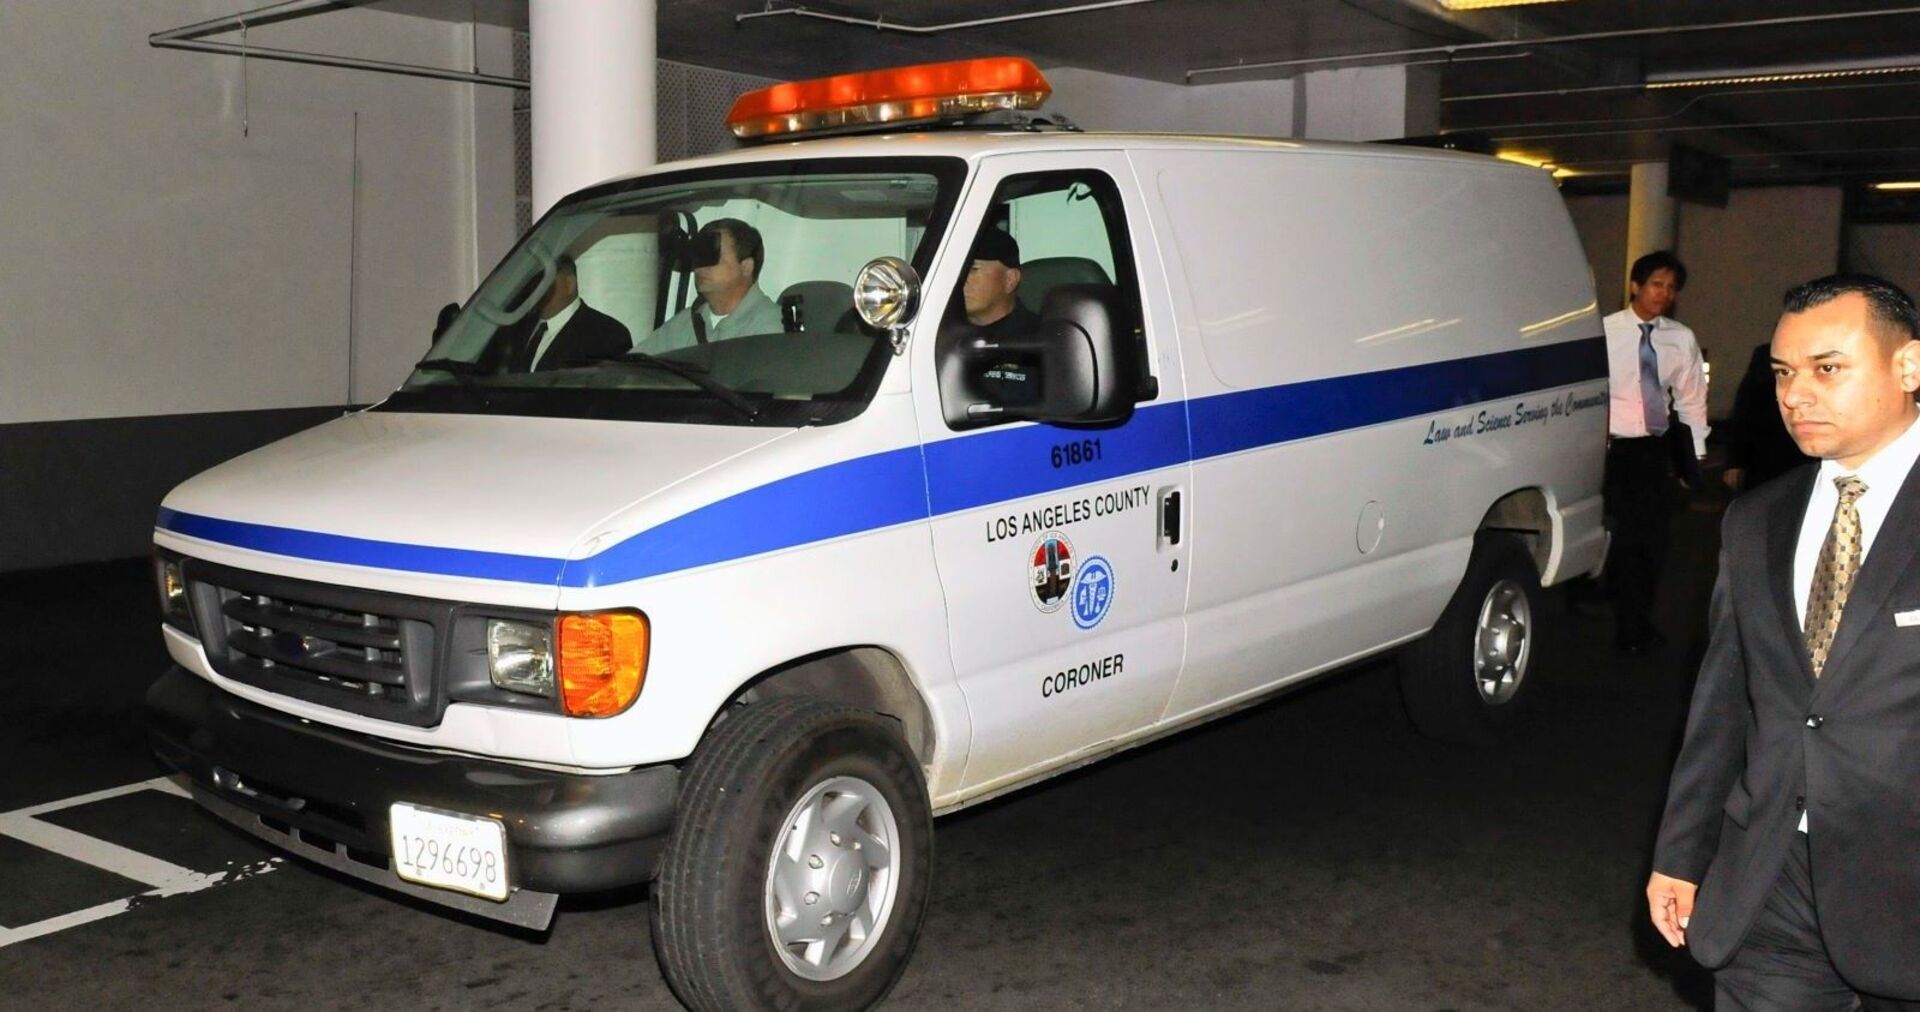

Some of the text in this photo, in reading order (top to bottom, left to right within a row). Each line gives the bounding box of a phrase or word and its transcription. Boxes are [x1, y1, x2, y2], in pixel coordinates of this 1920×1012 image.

[1423, 419, 1451, 445] Law
[1453, 415, 1474, 438] and
[1476, 410, 1512, 434] Science
[1514, 402, 1549, 425] Serving
[1551, 396, 1563, 417] the
[1051, 439, 1102, 469] 61861
[986, 515, 1018, 542] LOS
[1021, 498, 1091, 533] ANGELES
[1094, 484, 1151, 517] COUNTY
[1042, 653, 1124, 698] CORONER
[402, 835, 497, 883] 1296698
